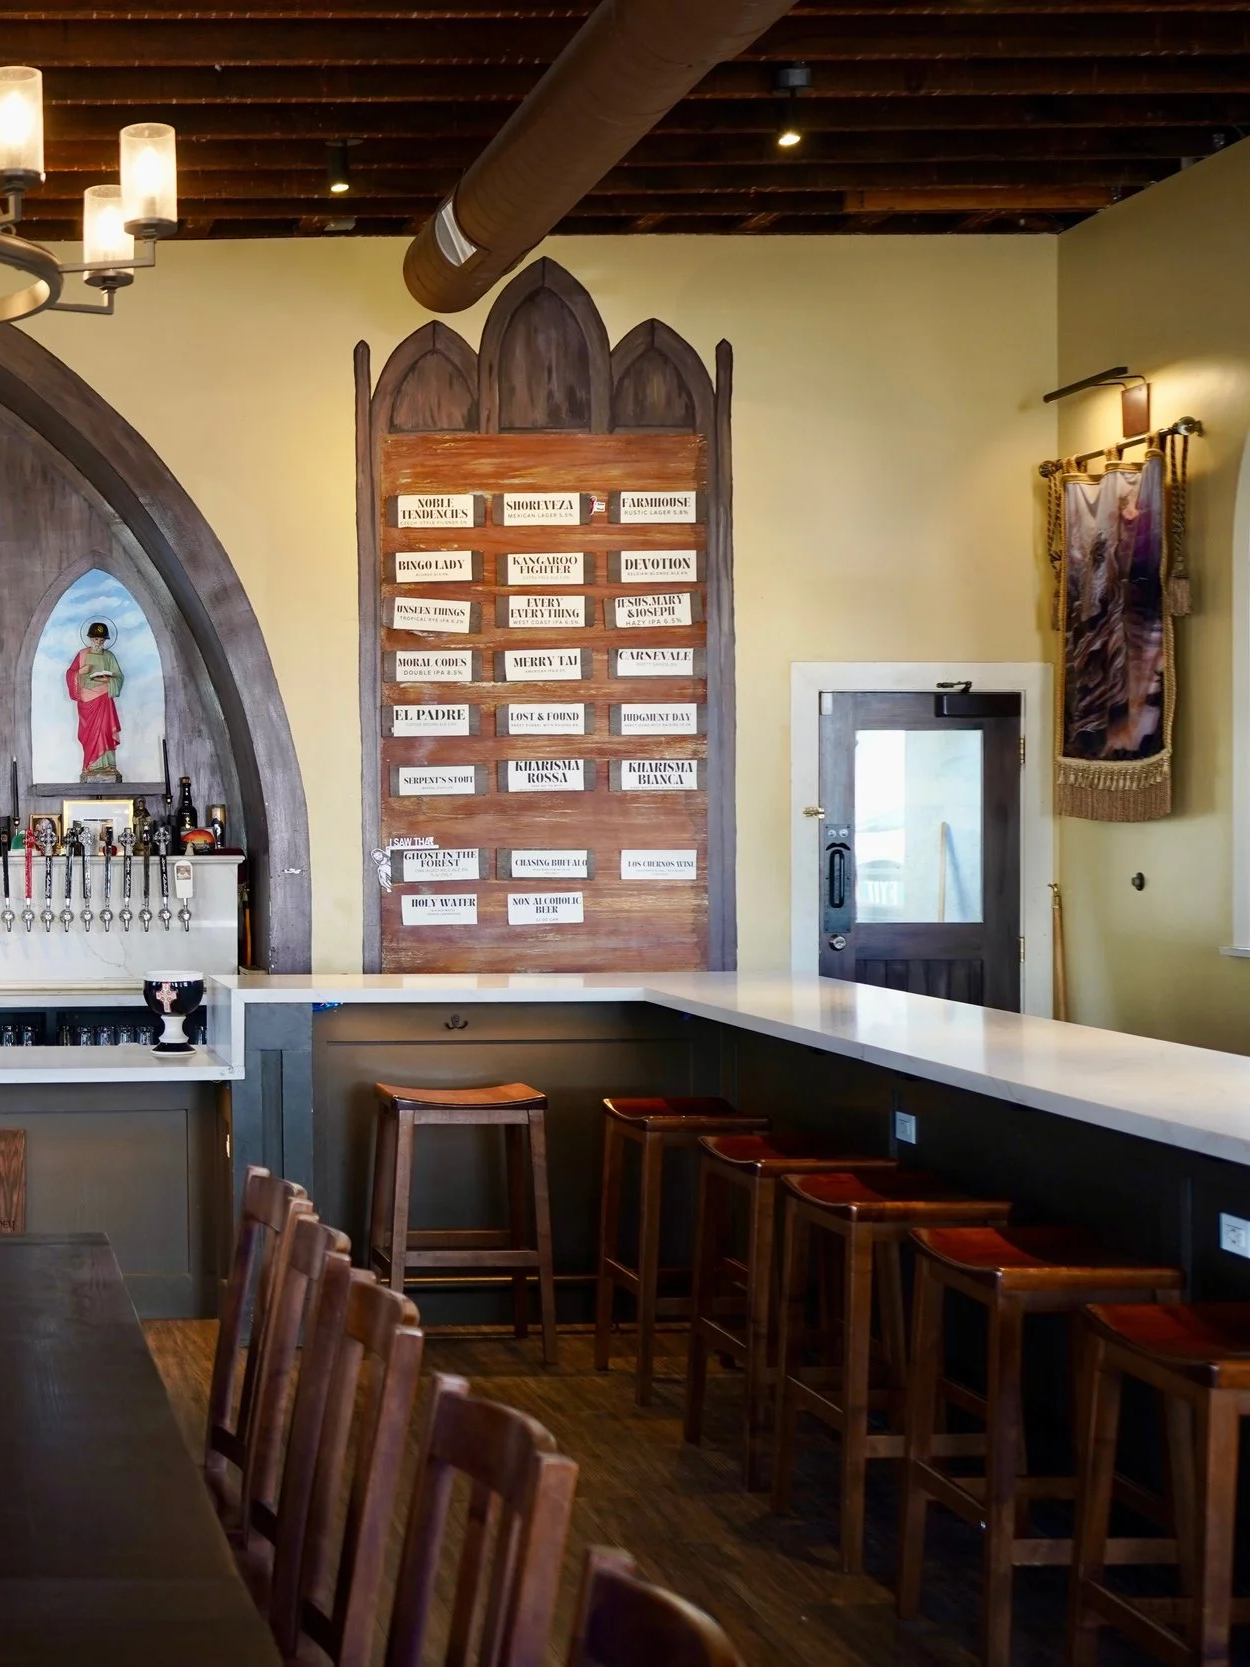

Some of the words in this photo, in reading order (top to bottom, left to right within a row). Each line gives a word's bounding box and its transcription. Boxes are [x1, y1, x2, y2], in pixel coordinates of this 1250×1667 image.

[417, 498, 454, 509] NOBLE
[506, 500, 574, 511] SHOREVEZA
[622, 497, 690, 508] FARMHOUSE
[400, 509, 469, 520] TENDENCIES
[398, 560, 433, 571] BINGO
[435, 559, 465, 570] LADY
[513, 556, 578, 566] KANGAROO
[625, 558, 691, 570] DEVOTION
[520, 565, 571, 574] FIGHTER
[527, 598, 563, 608] EVERY
[396, 604, 431, 616] UNSEEN
[433, 606, 466, 617] THINGS
[510, 608, 580, 618] EVERYTHING
[619, 651, 691, 661] CARNEVALE
[397, 658, 433, 668] MORAL
[434, 658, 467, 668] CODES
[514, 656, 555, 668] MERRY
[557, 655, 578, 666] TAJ
[395, 709, 413, 721] EL
[416, 709, 466, 721] PADRE
[510, 712, 535, 721] LOST
[537, 712, 544, 721] &
[546, 712, 580, 721] FOUND
[623, 713, 671, 722] JUDGMENT
[672, 713, 692, 721] DAY
[515, 760, 580, 772] KHARISMA
[629, 762, 693, 773] KHARISMA
[403, 776, 447, 785] SERPENT'S
[448, 775, 474, 784] STOUT
[527, 772, 568, 783] ROSSA
[638, 774, 684, 785] BIANCA
[393, 837, 413, 847] SAW
[404, 852, 441, 861] GHOST
[442, 851, 454, 859] IN
[456, 851, 477, 859] THE
[420, 859, 461, 868] FOREST
[515, 859, 550, 867] CHASING
[551, 859, 588, 867] BUFFALO
[411, 898, 439, 907] HOLY
[440, 898, 476, 907] WATER
[512, 897, 530, 906] NON
[532, 896, 582, 905] ALCOHOLIC
[535, 905, 559, 914] BEER
